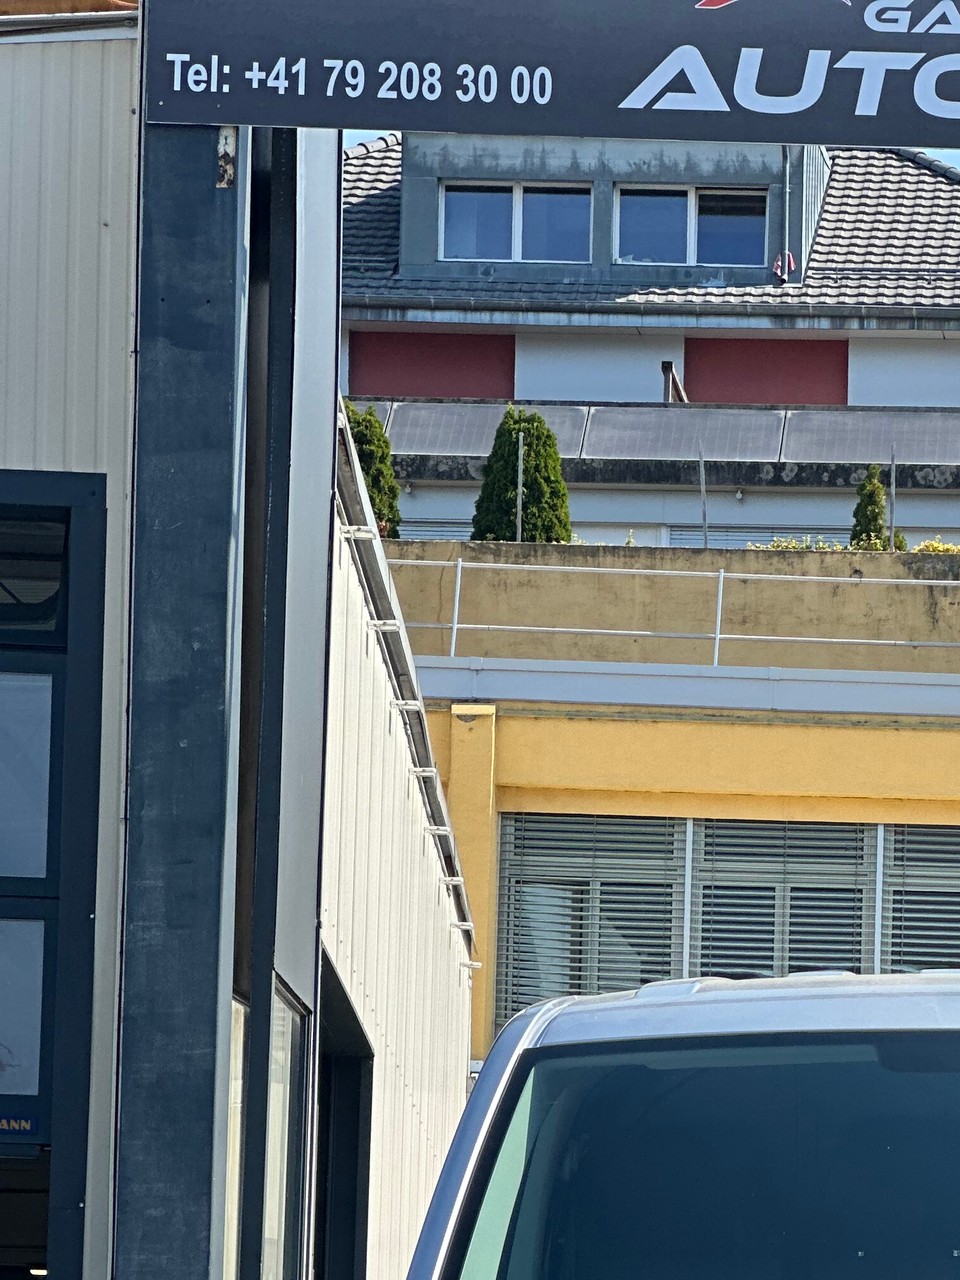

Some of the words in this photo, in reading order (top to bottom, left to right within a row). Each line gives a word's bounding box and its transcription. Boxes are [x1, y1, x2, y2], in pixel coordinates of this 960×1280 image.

[166, 53, 230, 93] Tel:
[244, 57, 306, 95] +41
[323, 59, 365, 98] 79
[376, 61, 442, 101] 208
[455, 63, 498, 103] 30
[510, 66, 553, 105] 00
